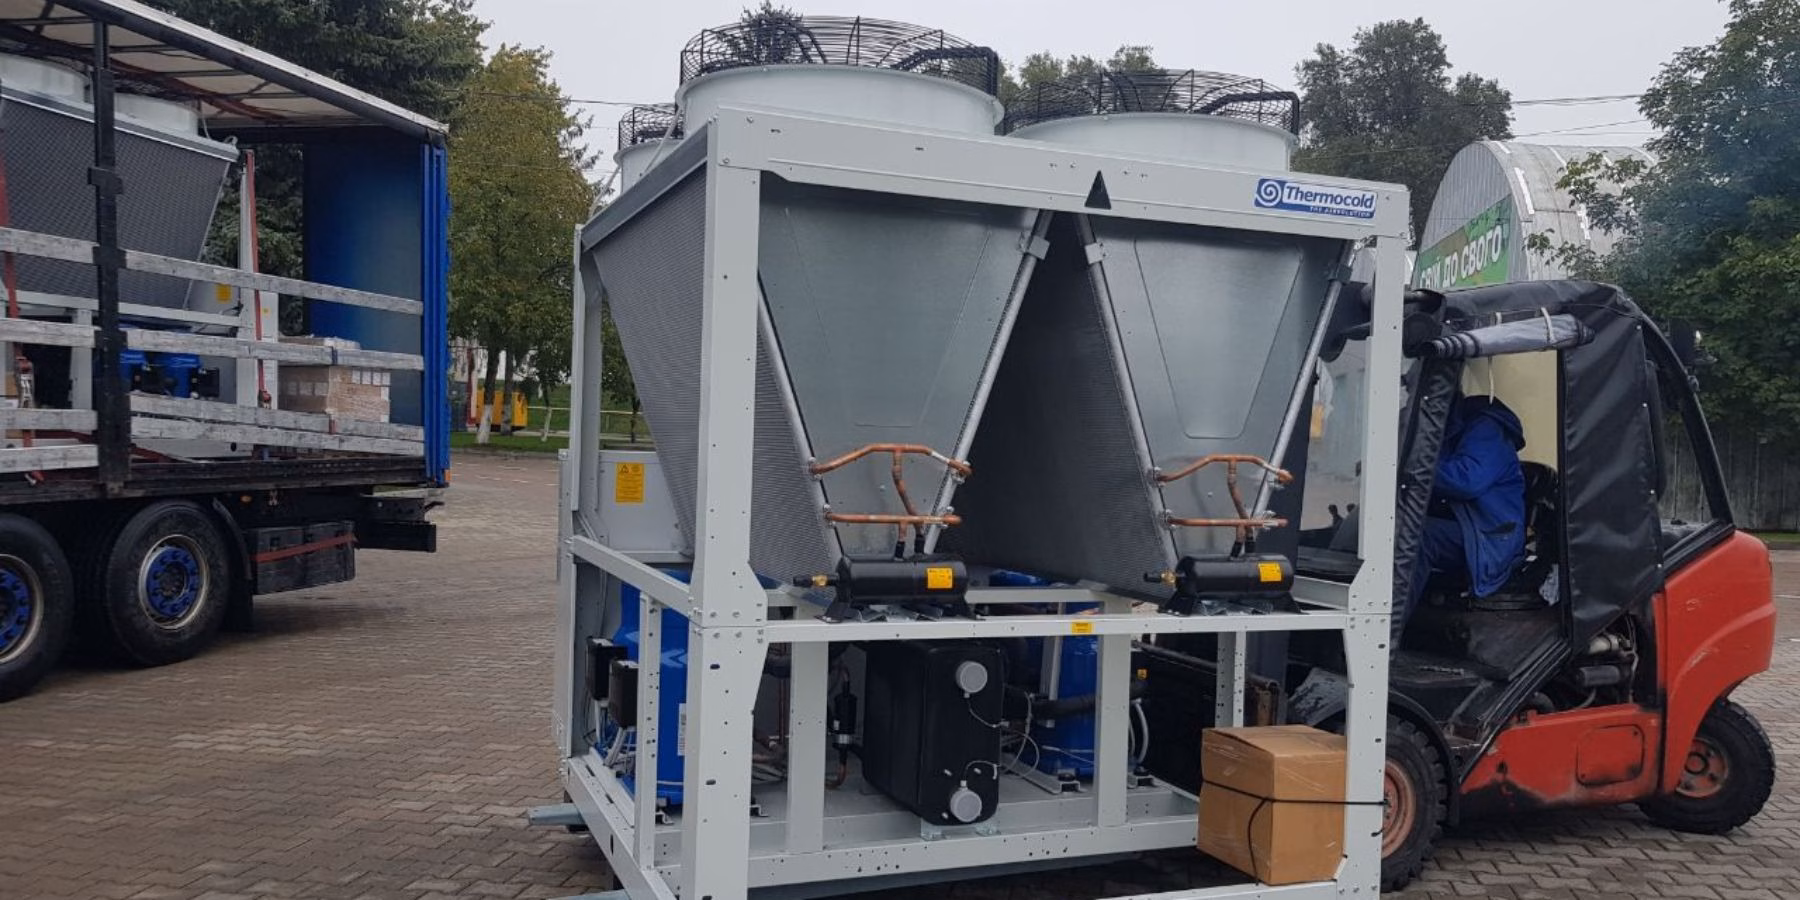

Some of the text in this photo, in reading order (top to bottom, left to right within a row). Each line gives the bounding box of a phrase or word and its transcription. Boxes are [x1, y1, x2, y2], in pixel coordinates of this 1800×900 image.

[1286, 186, 1374, 209] Thermocold
[1442, 252, 1459, 288] ДО
[1461, 224, 1502, 279] СВОГО
